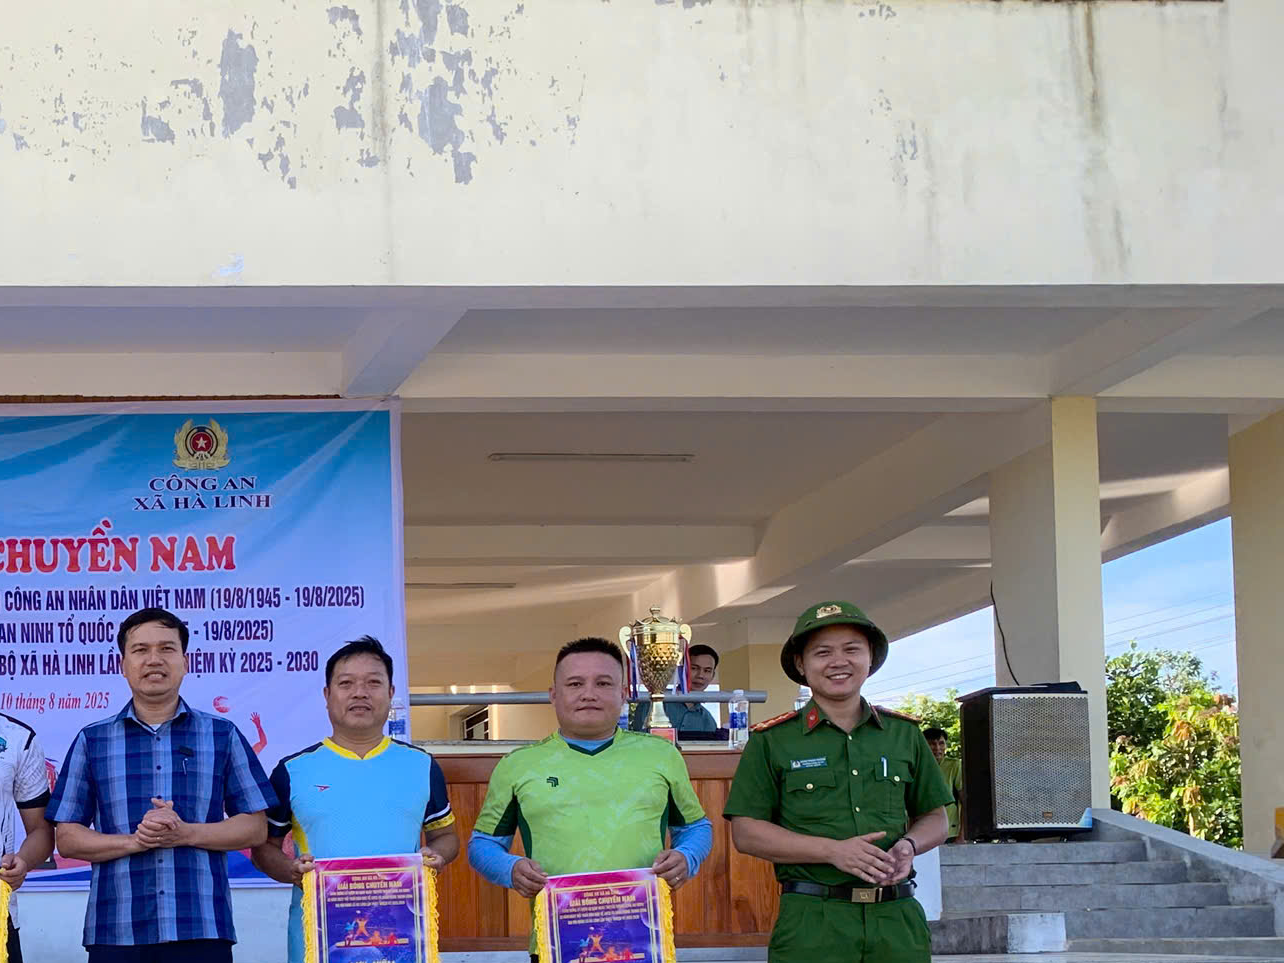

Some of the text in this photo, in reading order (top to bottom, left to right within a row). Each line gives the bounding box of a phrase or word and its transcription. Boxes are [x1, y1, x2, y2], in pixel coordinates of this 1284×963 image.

[149, 474, 255, 491] CÔNG AN
[134, 493, 271, 510] XÃ HÀ LINH
[149, 536, 236, 571] NAM
[4, 586, 41, 611] CÔNG
[46, 591, 65, 611] AN
[69, 586, 106, 610] NHÂN
[110, 586, 138, 610] DÂN
[142, 584, 170, 609] VIỆT
[174, 588, 205, 609] NAM
[211, 587, 281, 611] (19/8/1945
[294, 586, 364, 608] 19/8/2025)
[21, 622, 54, 643] NINH
[58, 614, 74, 643] TỔ
[79, 615, 114, 645] QUỐC
[203, 619, 274, 642] 19/8/2025)
[20, 651, 37, 676] XÃ
[42, 650, 61, 675] HÀ
[65, 654, 95, 675] LINH
[186, 648, 215, 678] IỆM
[219, 647, 236, 673] KỲ
[240, 652, 273, 673] 2025
[286, 651, 319, 672] 2030
[0, 693, 13, 710] 10
[15, 692, 46, 714] tháng
[48, 692, 55, 709] 8
[58, 693, 81, 709] năm
[84, 691, 110, 709] 2025
